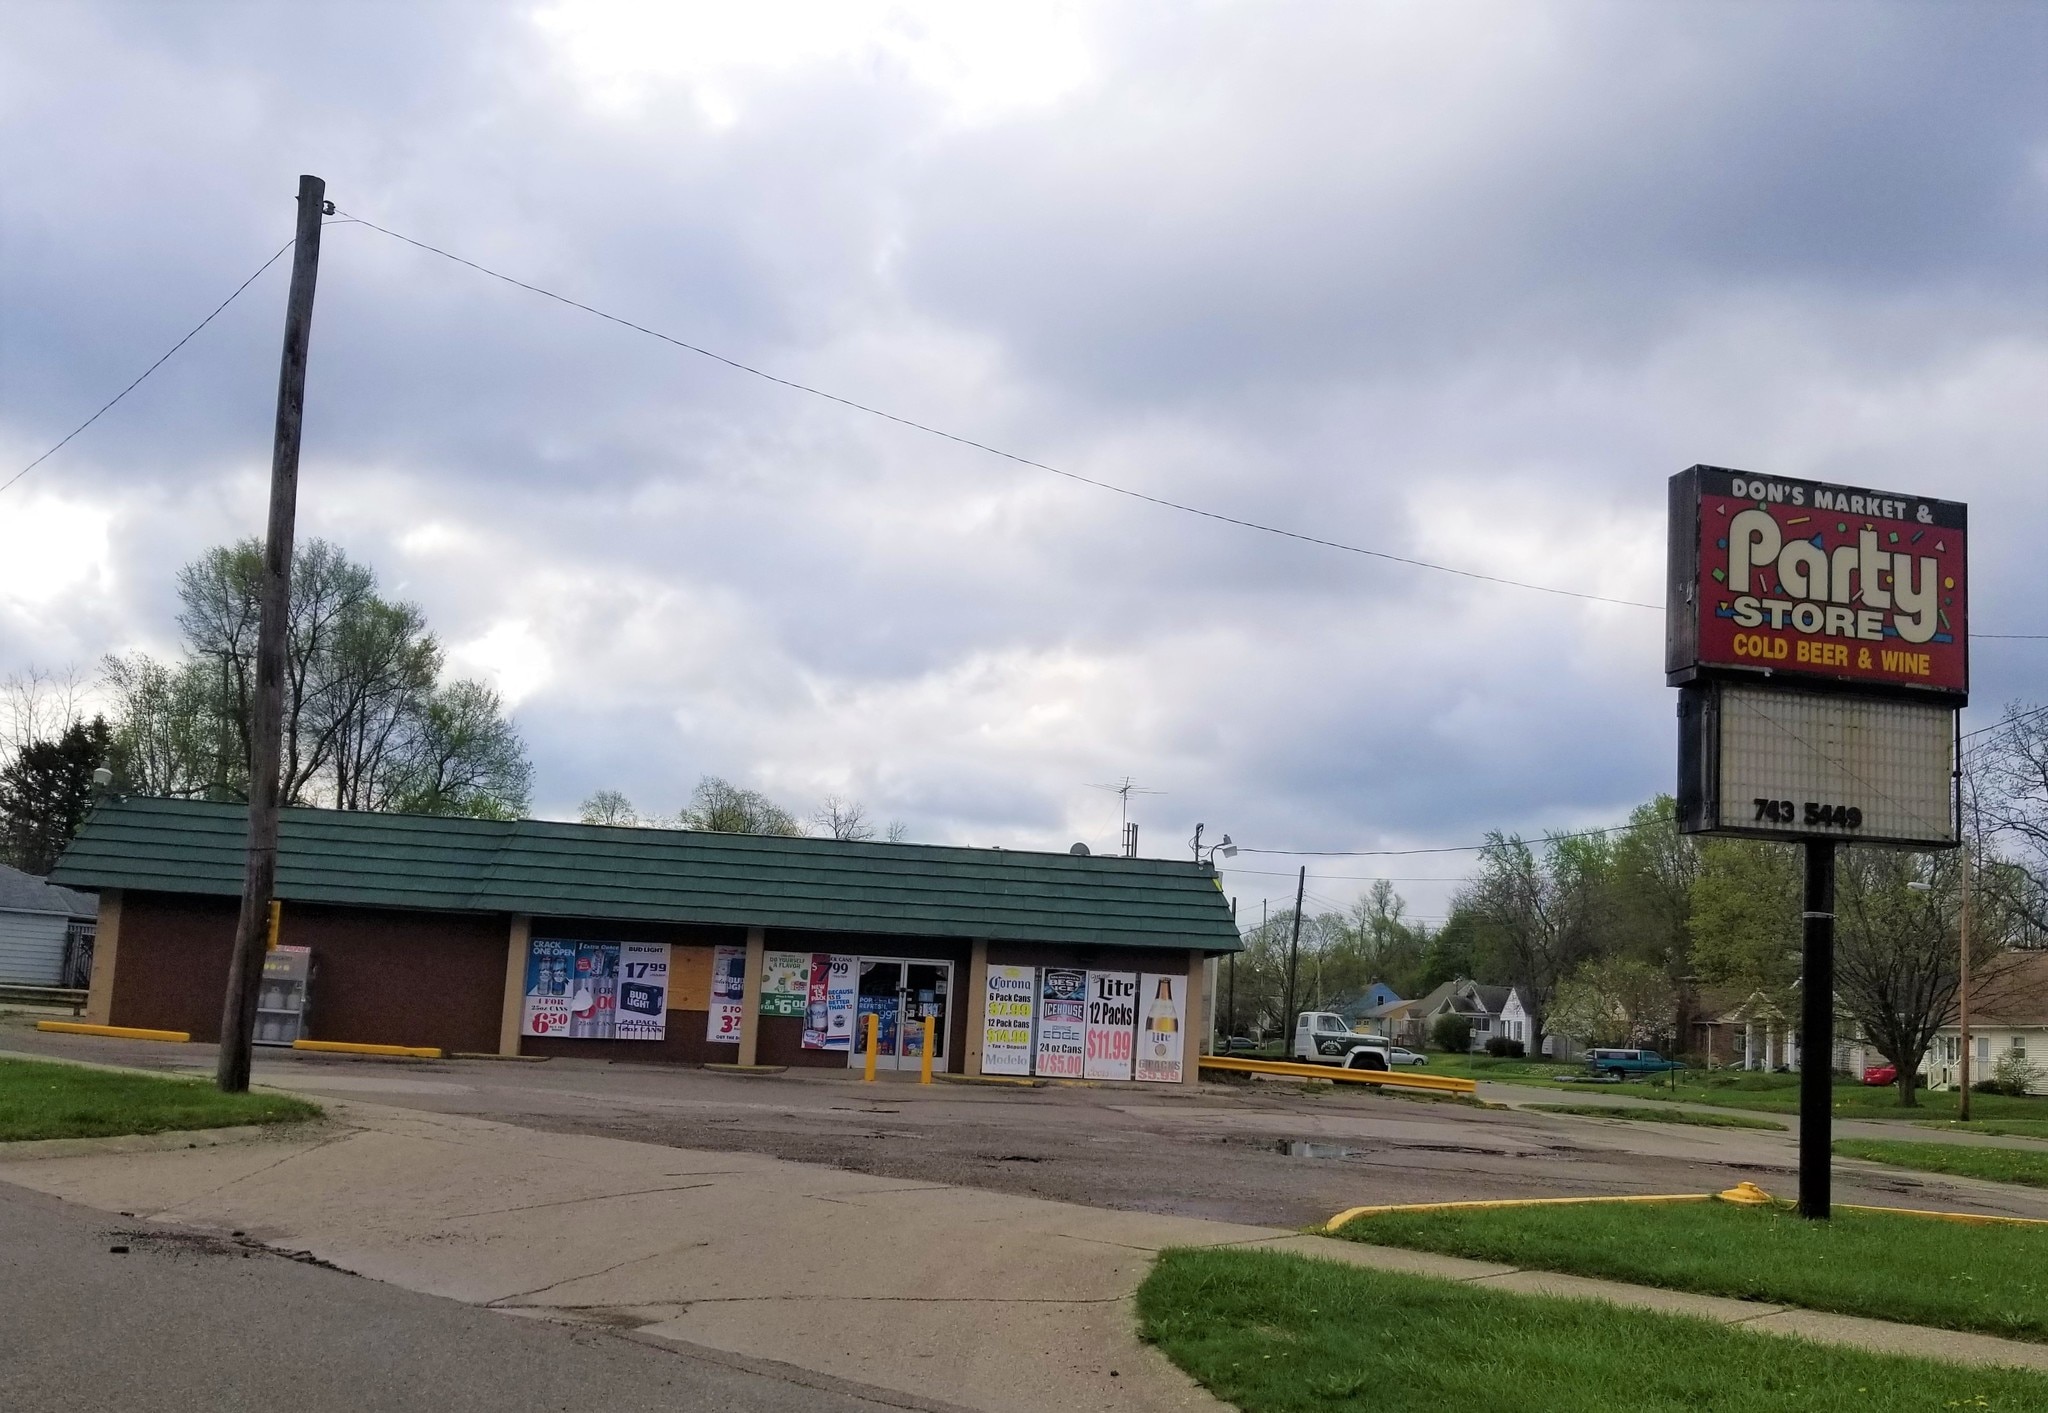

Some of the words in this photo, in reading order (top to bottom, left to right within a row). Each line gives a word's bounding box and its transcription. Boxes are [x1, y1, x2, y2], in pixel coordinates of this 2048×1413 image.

[1732, 479, 1804, 505] DON'S
[1814, 490, 1906, 520] MARKET
[1916, 504, 1934, 524] &
[1728, 509, 1938, 643] Party
[1732, 596, 1884, 641] STORE
[1733, 633, 1788, 659] COLD
[1796, 641, 1848, 667] BEER
[1858, 647, 1873, 670] &
[1881, 650, 1930, 676] WINE
[1753, 798, 1795, 823] 743
[1803, 802, 1862, 828] 5449
[533, 941, 561, 949] CRACK
[989, 976, 1031, 991] Corona
[1049, 979, 1080, 987] BEST
[1098, 978, 1134, 1000] Lite
[629, 990, 648, 1000] BUD
[989, 993, 994, 1001] 6
[1014, 994, 1031, 1002] Cans
[627, 999, 649, 1009] LIGHT
[988, 1001, 1031, 1017] $7.99
[1044, 1002, 1083, 1019] ICEHOUSE
[1089, 1002, 1100, 1024] 12
[1102, 1003, 1132, 1026] Packs
[988, 1019, 996, 1027] 12
[996, 1020, 1012, 1028] Pack
[1013, 1020, 1030, 1029] Cans
[1043, 1030, 1080, 1040] EDGE
[1040, 1043, 1049, 1052] 24
[1051, 1045, 1060, 1053] oz
[1062, 1044, 1082, 1054] Cans
[1087, 1027, 1131, 1061] $11.99
[985, 1053, 1027, 1065] Modelo
[1037, 1054, 1080, 1074] 4/$5.00
